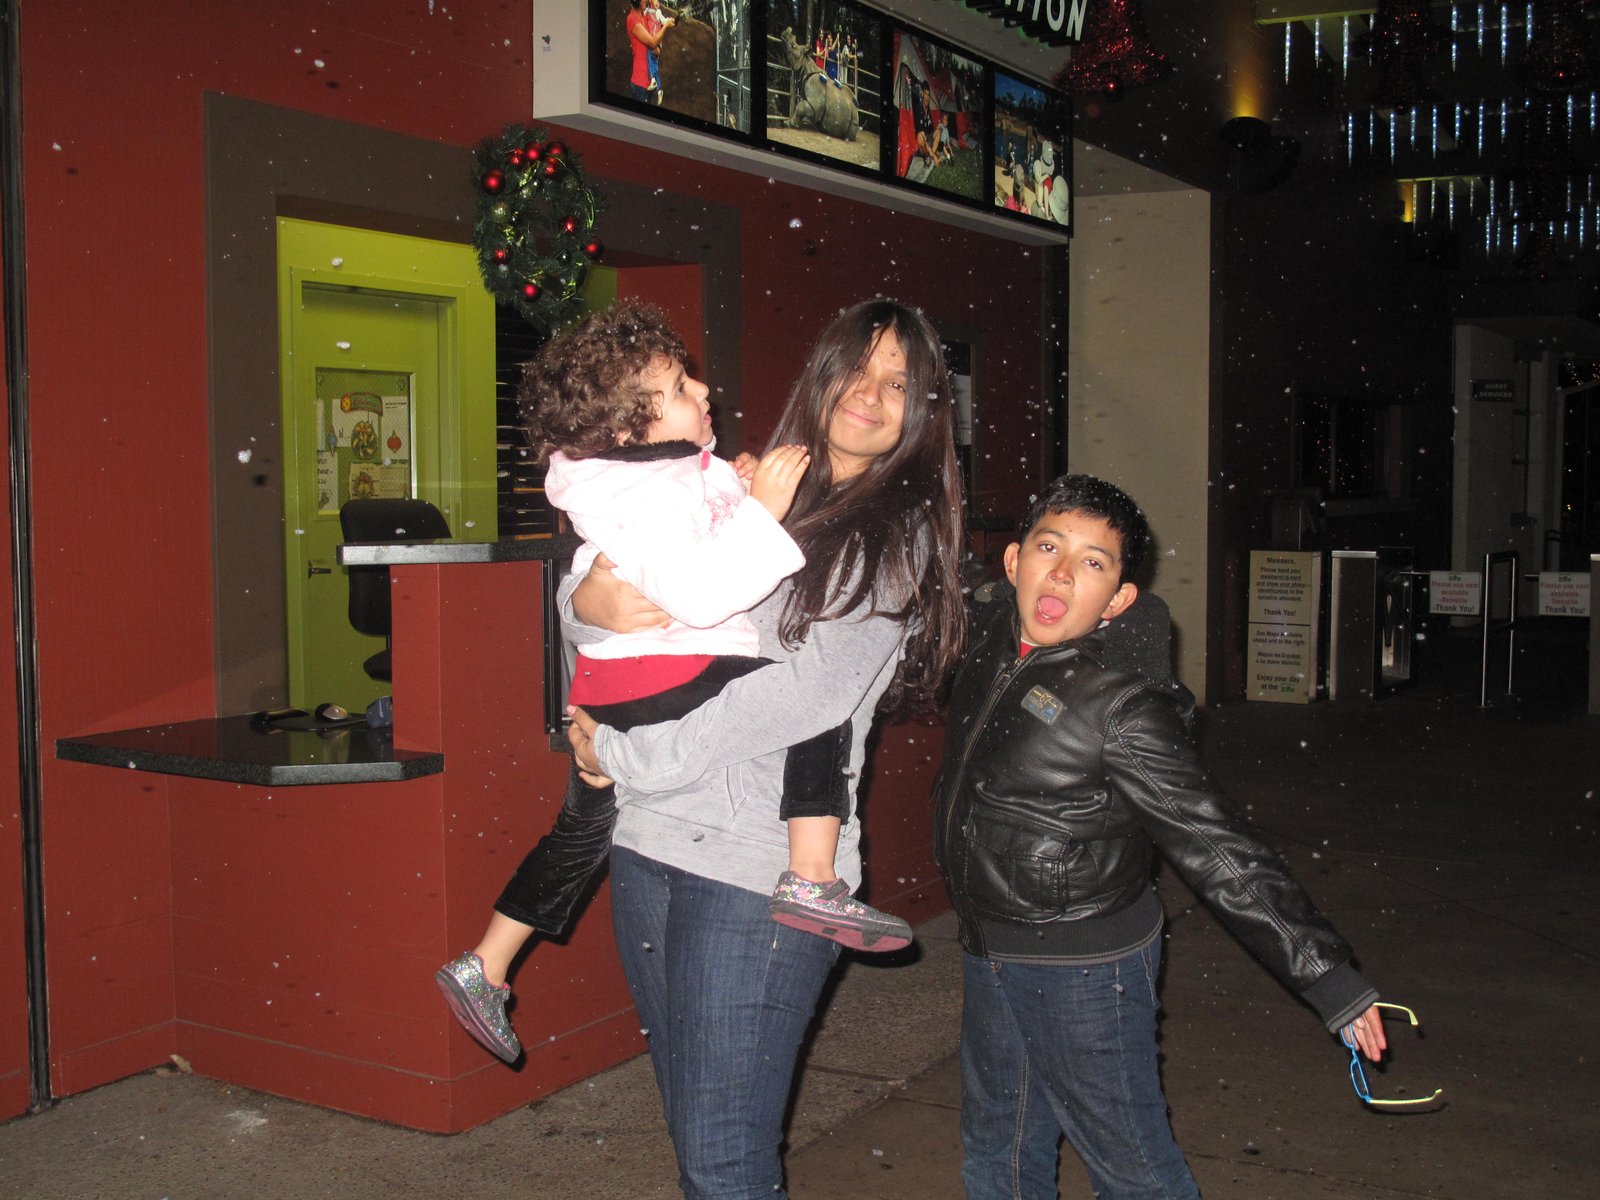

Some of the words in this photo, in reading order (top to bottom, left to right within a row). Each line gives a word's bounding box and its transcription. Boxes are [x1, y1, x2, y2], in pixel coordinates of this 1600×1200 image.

[1263, 608, 1282, 616] Thank
[1435, 604, 1457, 612] Thank
[1458, 604, 1475, 613] You!
